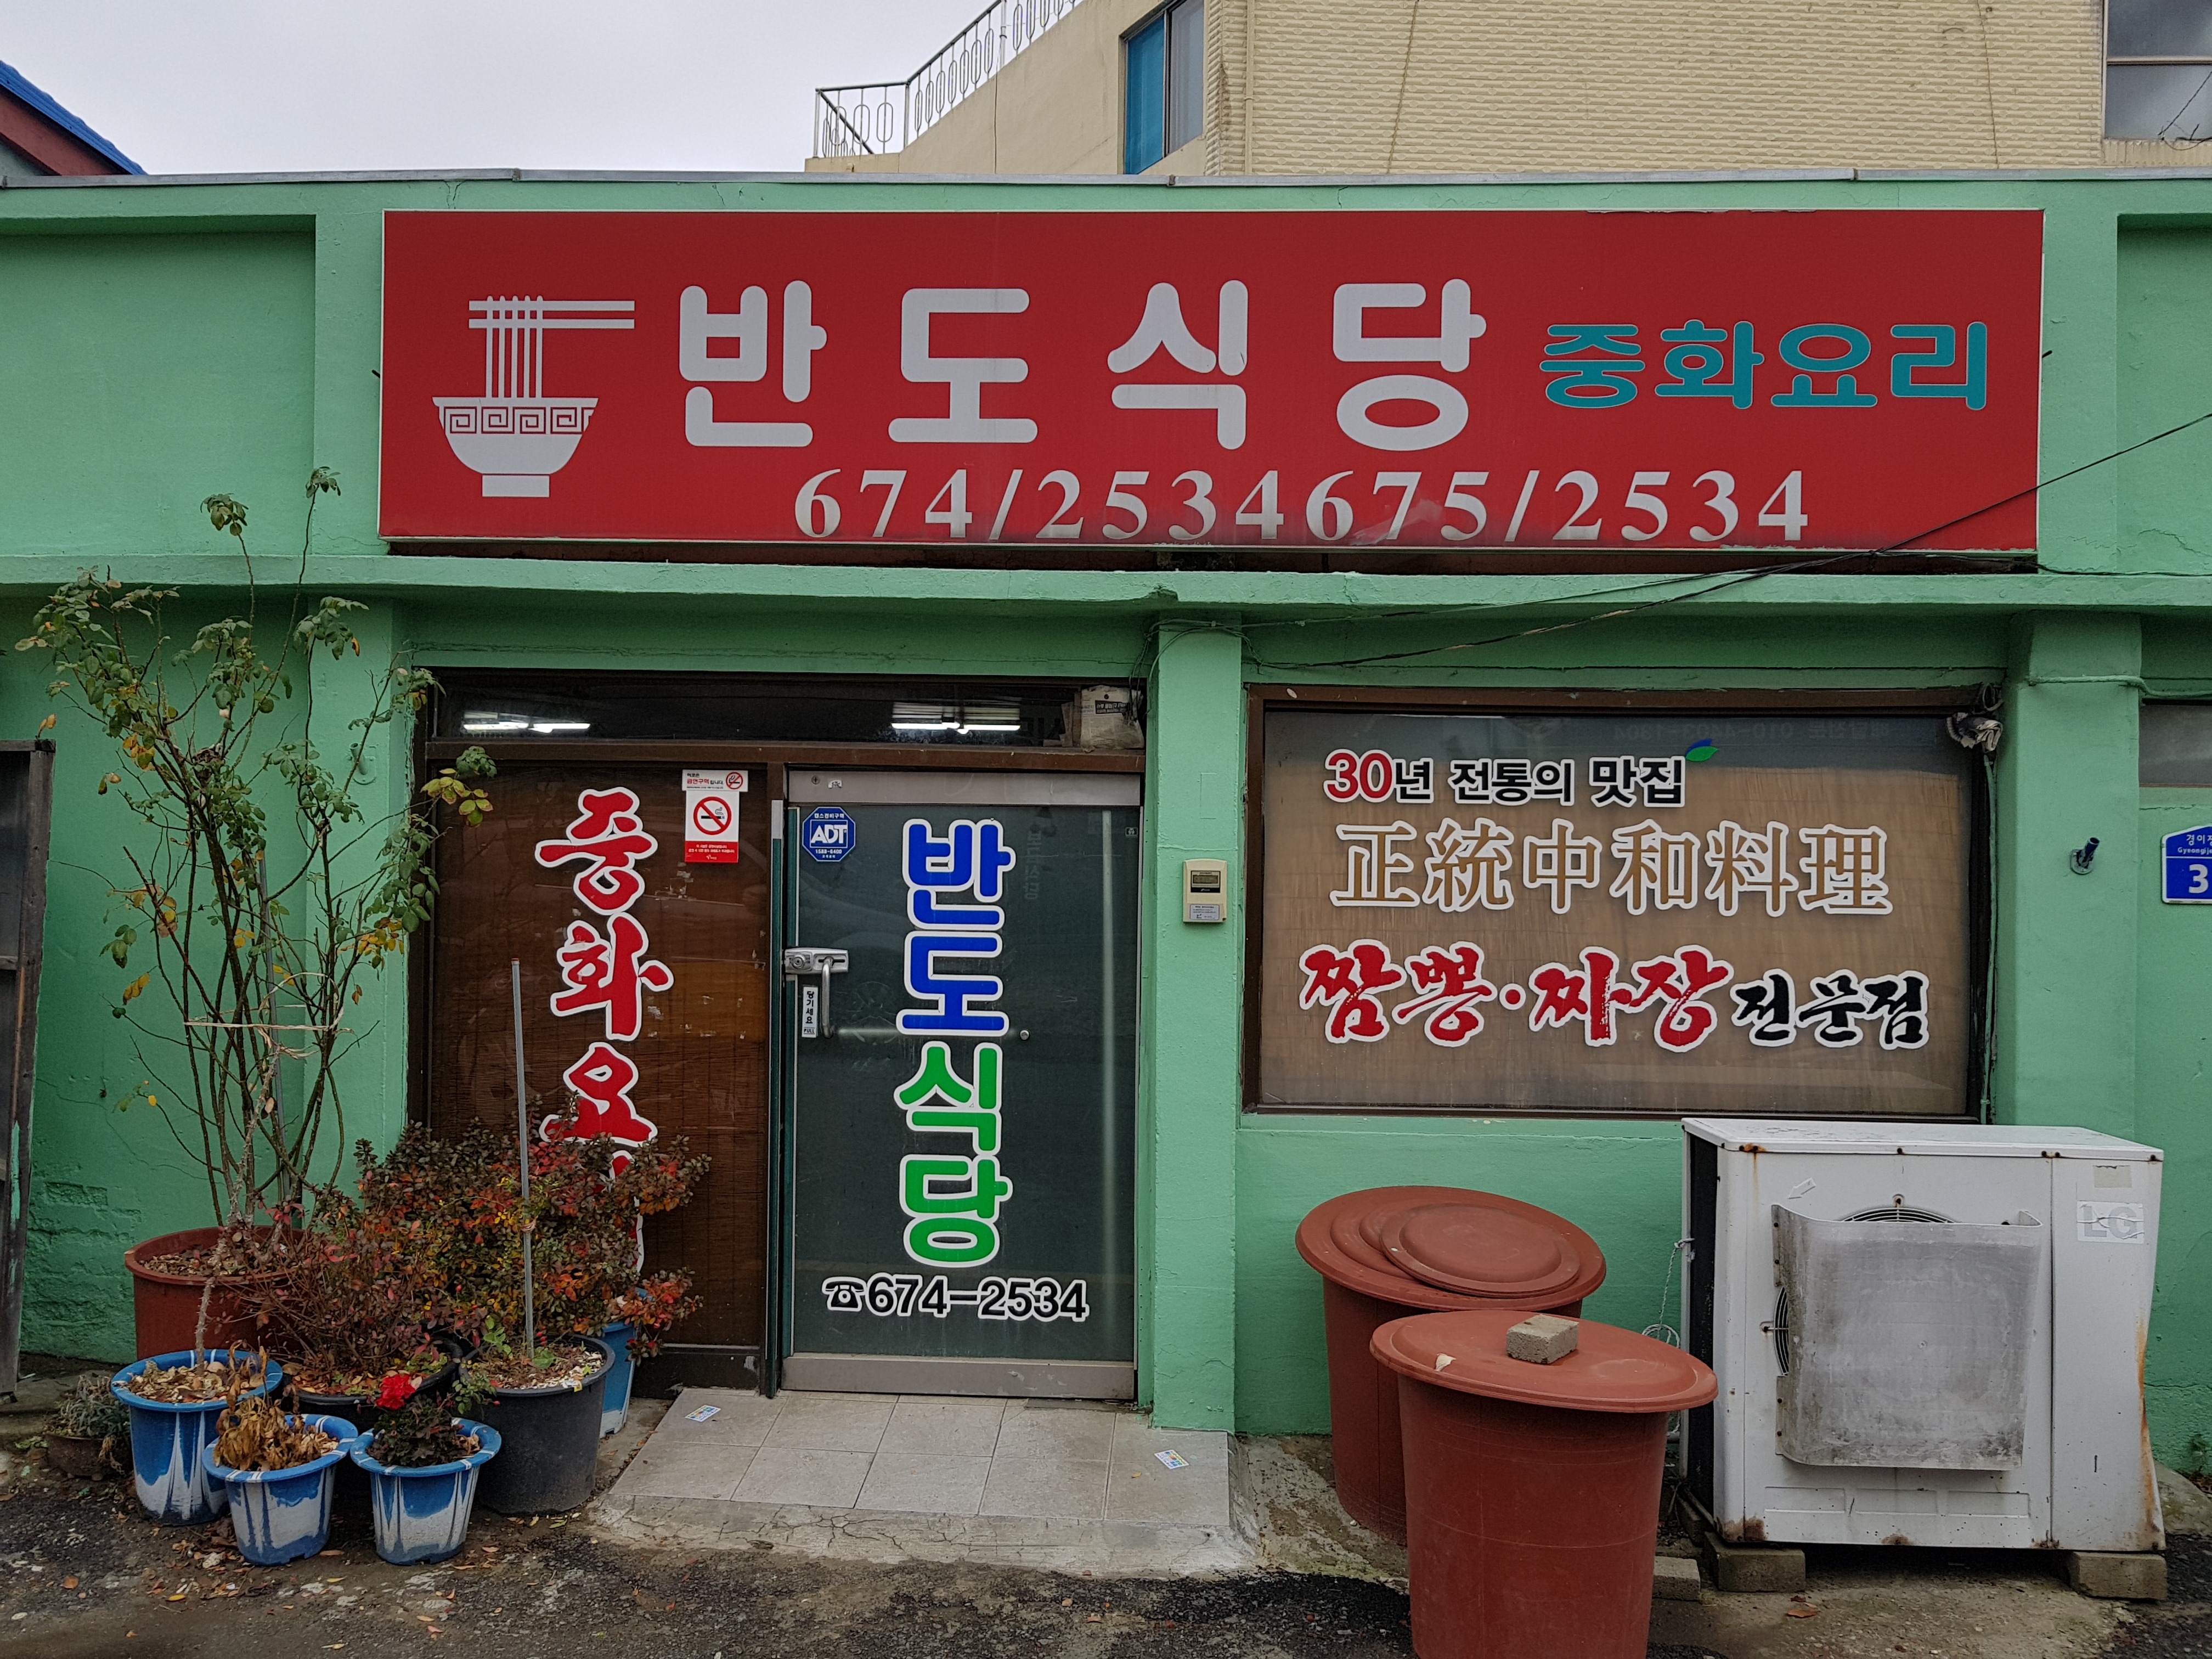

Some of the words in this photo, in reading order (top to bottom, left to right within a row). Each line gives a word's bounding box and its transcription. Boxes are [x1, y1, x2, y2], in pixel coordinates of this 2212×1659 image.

[679, 279, 1486, 452] 반도식당
[1539, 319, 1987, 410] 중화요리
[1323, 749, 1434, 803] 30년
[1448, 758, 1575, 806] 전통의
[1589, 755, 1685, 807] 맛집
[810, 824, 848, 844] ADT
[1329, 818, 1893, 917] 正統中和料理
[2188, 864, 2209, 894] 3
[534, 786, 674, 1273] 중화요
[805, 990, 815, 1024] 당기세요
[1729, 967, 1929, 1051] 전문점
[894, 819, 1015, 1268] 반도식당
[2083, 1205, 2138, 1240] LG
[865, 1272, 1090, 1322] 674-2534
